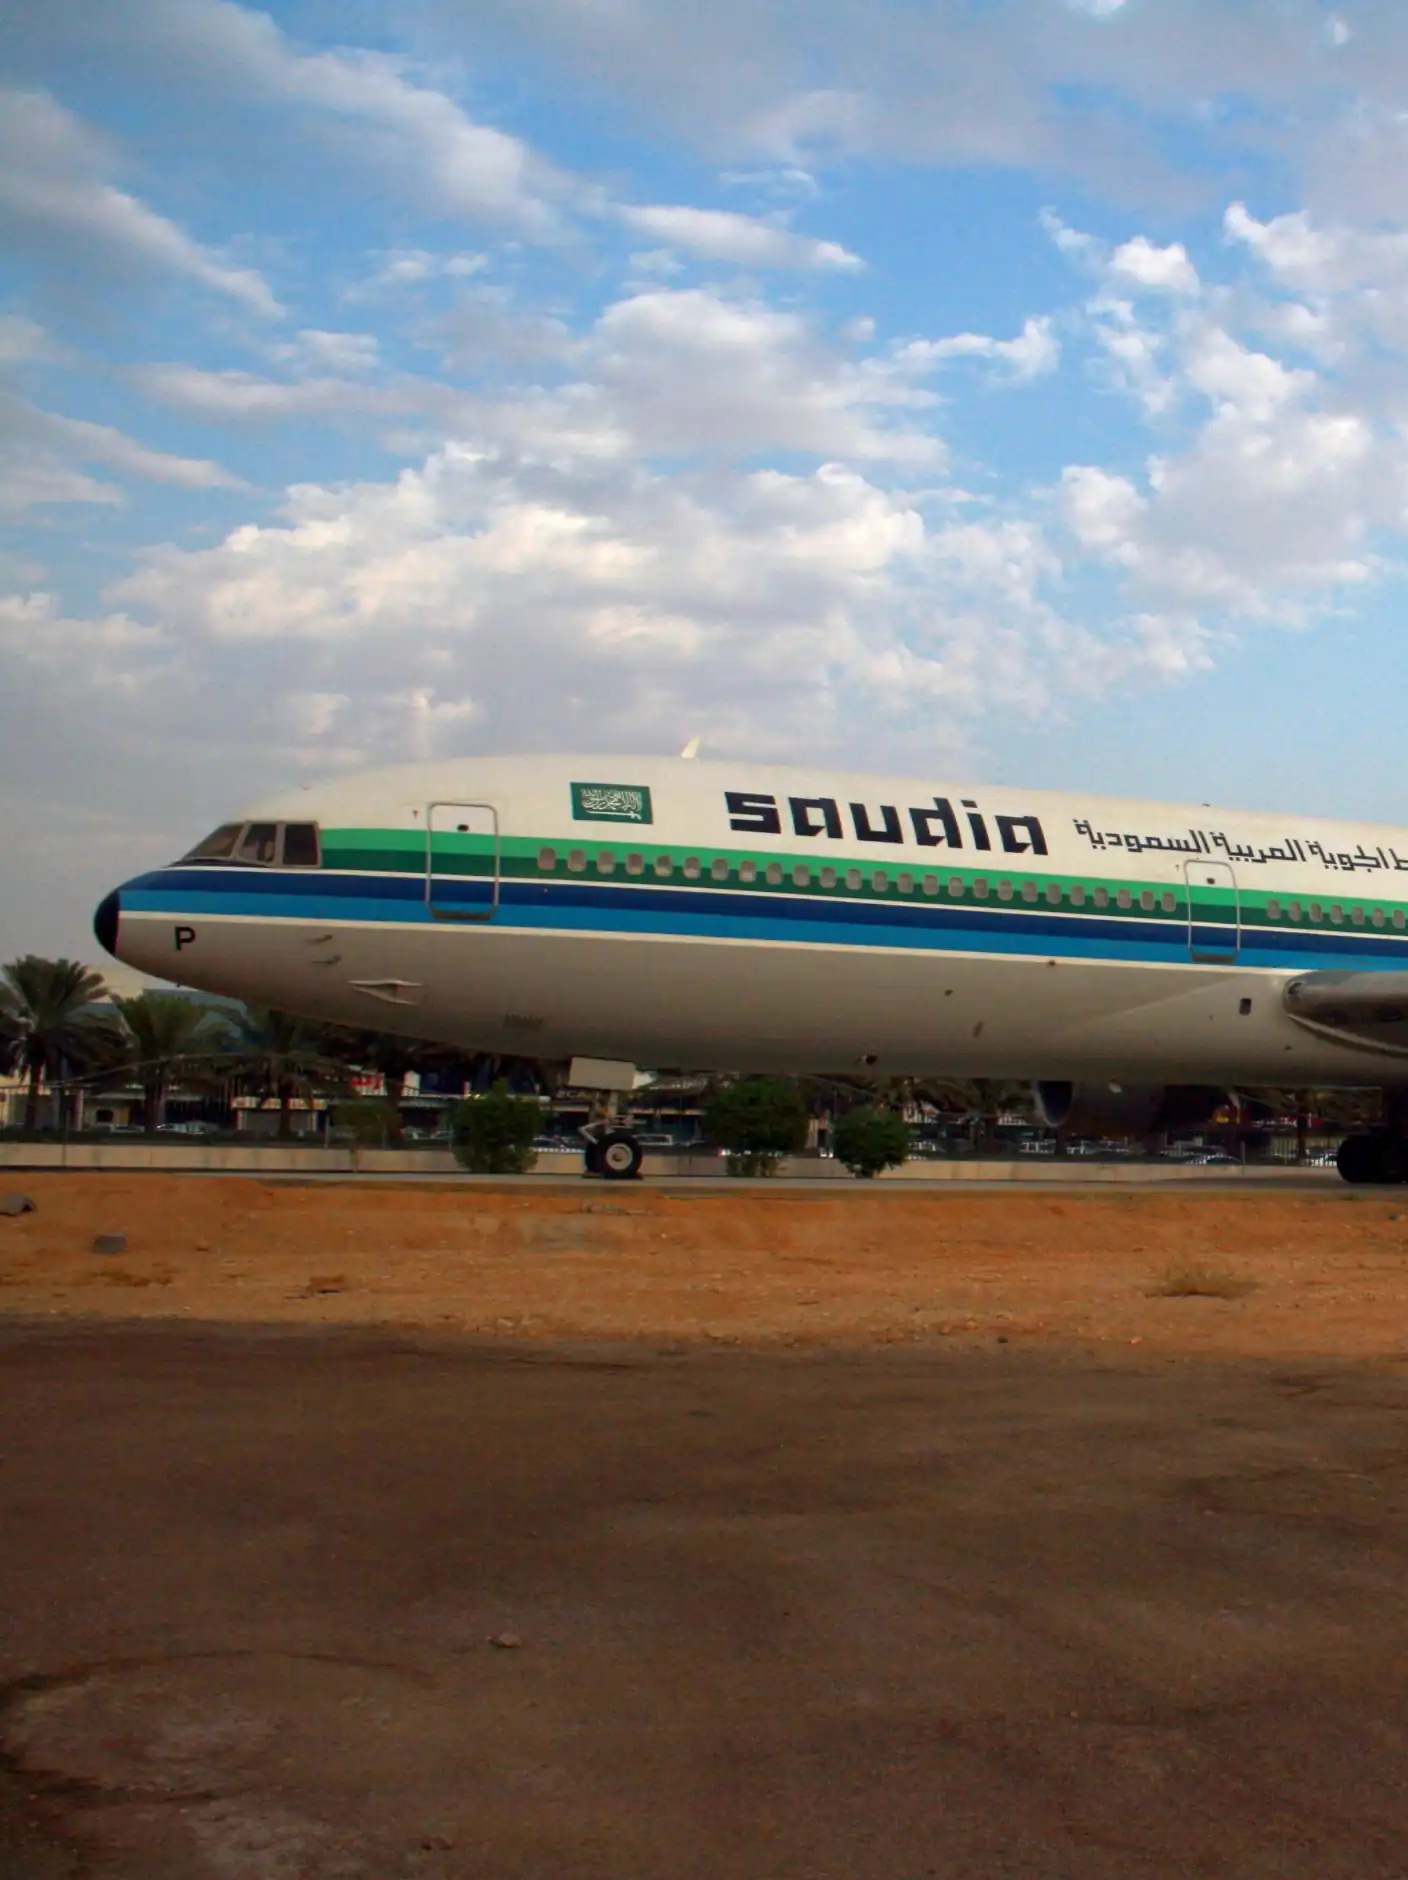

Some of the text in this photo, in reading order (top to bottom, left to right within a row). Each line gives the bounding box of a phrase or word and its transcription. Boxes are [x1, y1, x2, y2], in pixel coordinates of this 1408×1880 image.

[724, 791, 1048, 855] saudia
[1072, 818, 1211, 853] السعودية
[1210, 831, 1306, 864] العربية
[1305, 840, 1389, 873] الجوية
[174, 926, 196, 951] P
